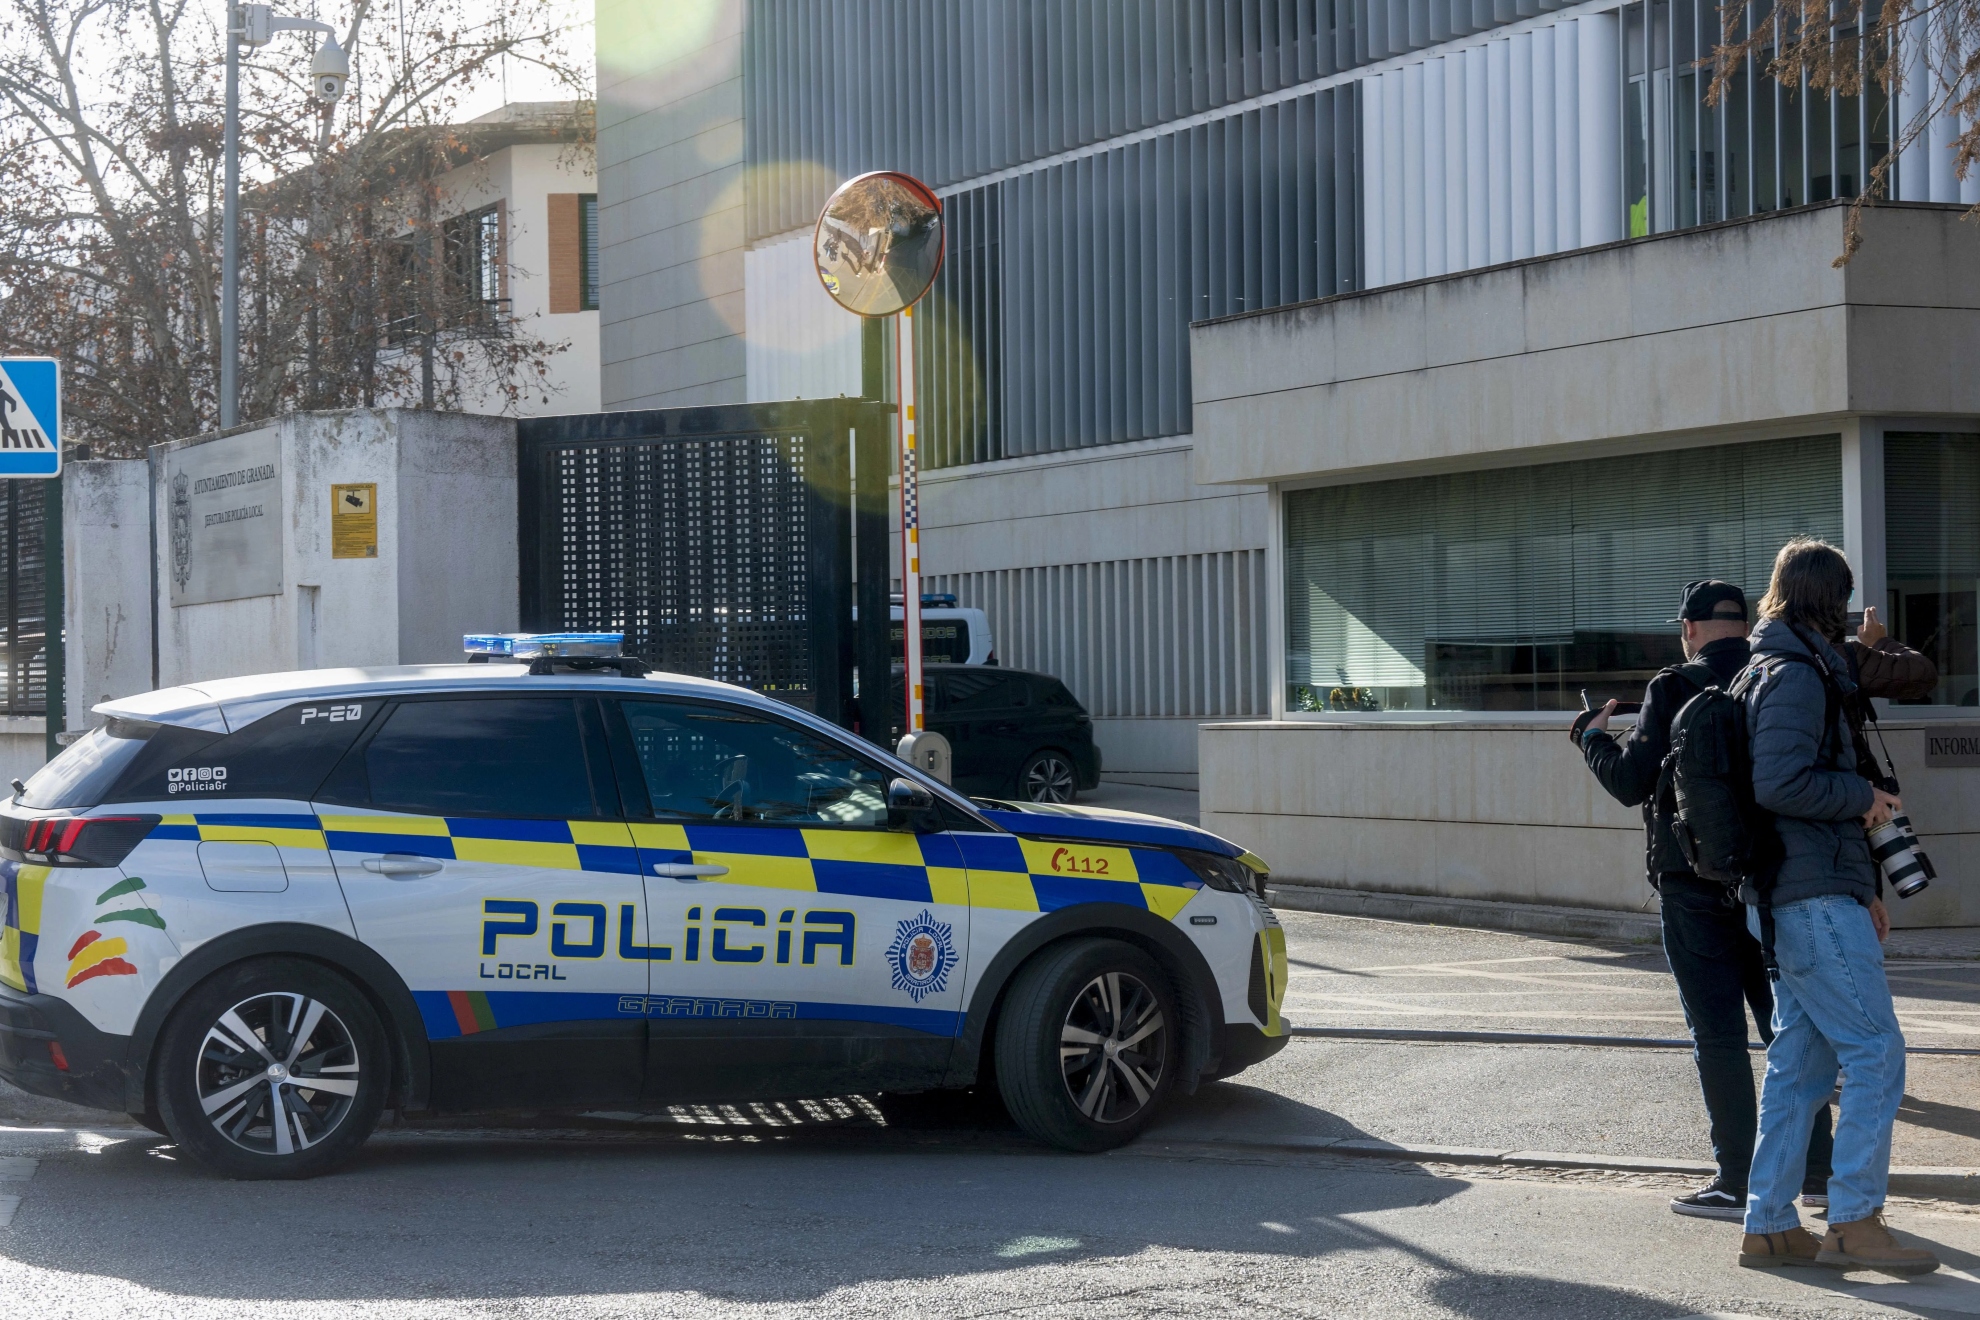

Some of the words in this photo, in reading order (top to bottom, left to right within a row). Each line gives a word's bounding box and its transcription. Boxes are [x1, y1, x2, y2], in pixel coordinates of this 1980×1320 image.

[194, 471, 237, 495] AYUNTAMIENTO
[237, 470, 246, 486] DE
[247, 463, 275, 484] GRANADA
[225, 510, 232, 523] DE
[249, 504, 264, 518] LOCAL
[168, 781, 228, 794] @PoliciaGr
[1066, 856, 1109, 875] 112
[928, 928, 944, 951] LOCAL
[480, 962, 567, 981] LOCAL
[905, 974, 935, 986] GRANADA
[618, 995, 797, 1019] GRANADA
